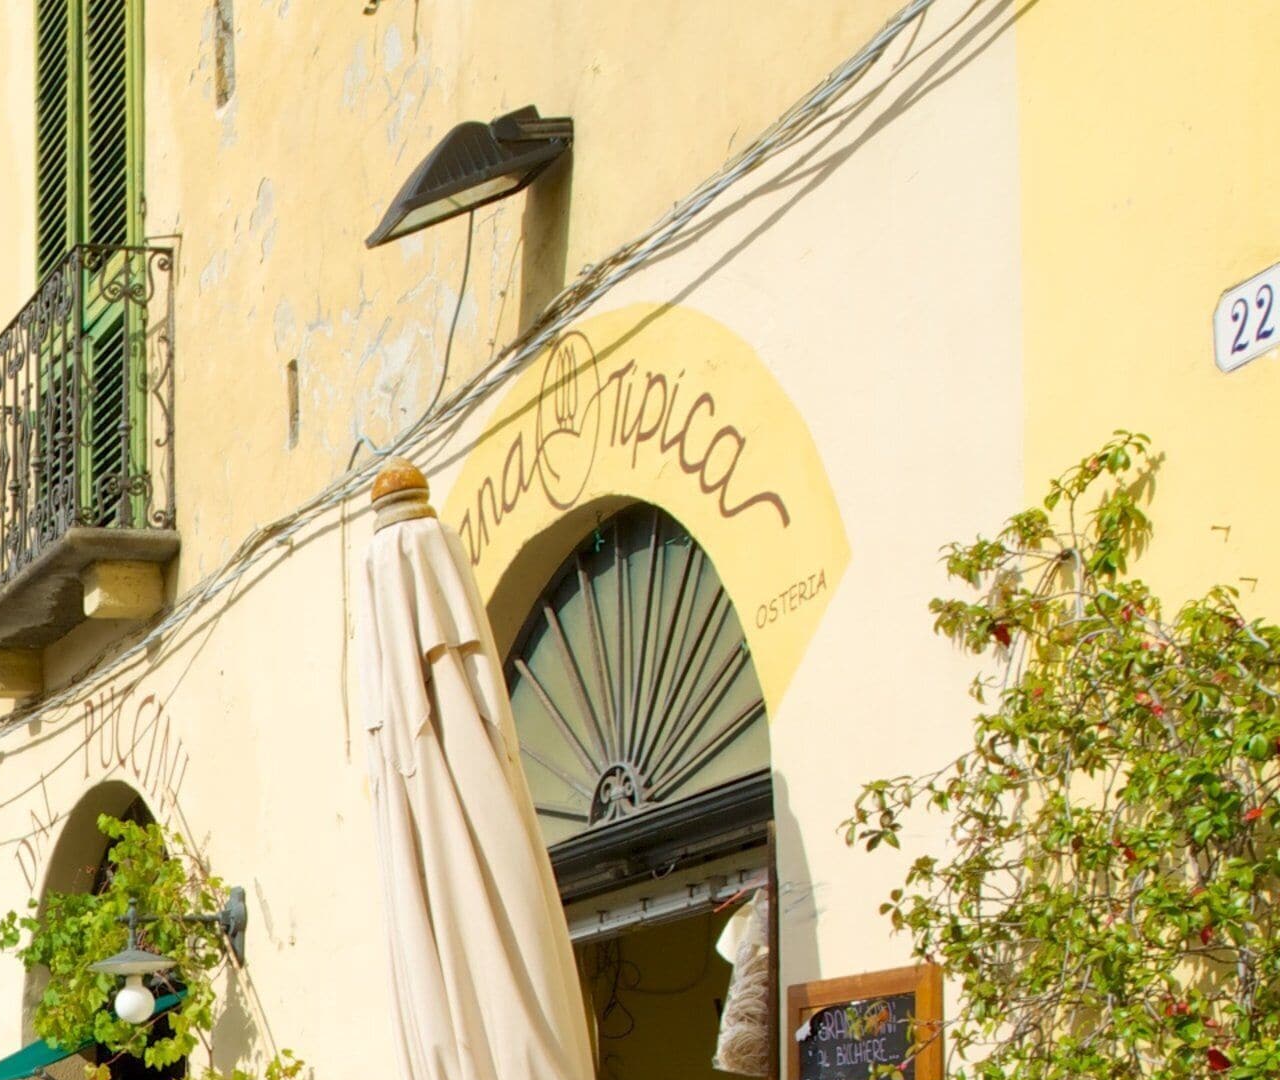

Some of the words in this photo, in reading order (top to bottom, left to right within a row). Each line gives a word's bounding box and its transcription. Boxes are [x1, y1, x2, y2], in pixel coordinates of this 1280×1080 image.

[1230, 284, 1274, 355] 22
[458, 431, 538, 566] ana
[607, 358, 791, 529] Tipica
[755, 567, 828, 630] OSTERIA
[14, 774, 59, 892] DAL
[83, 686, 190, 813] PUCCINI
